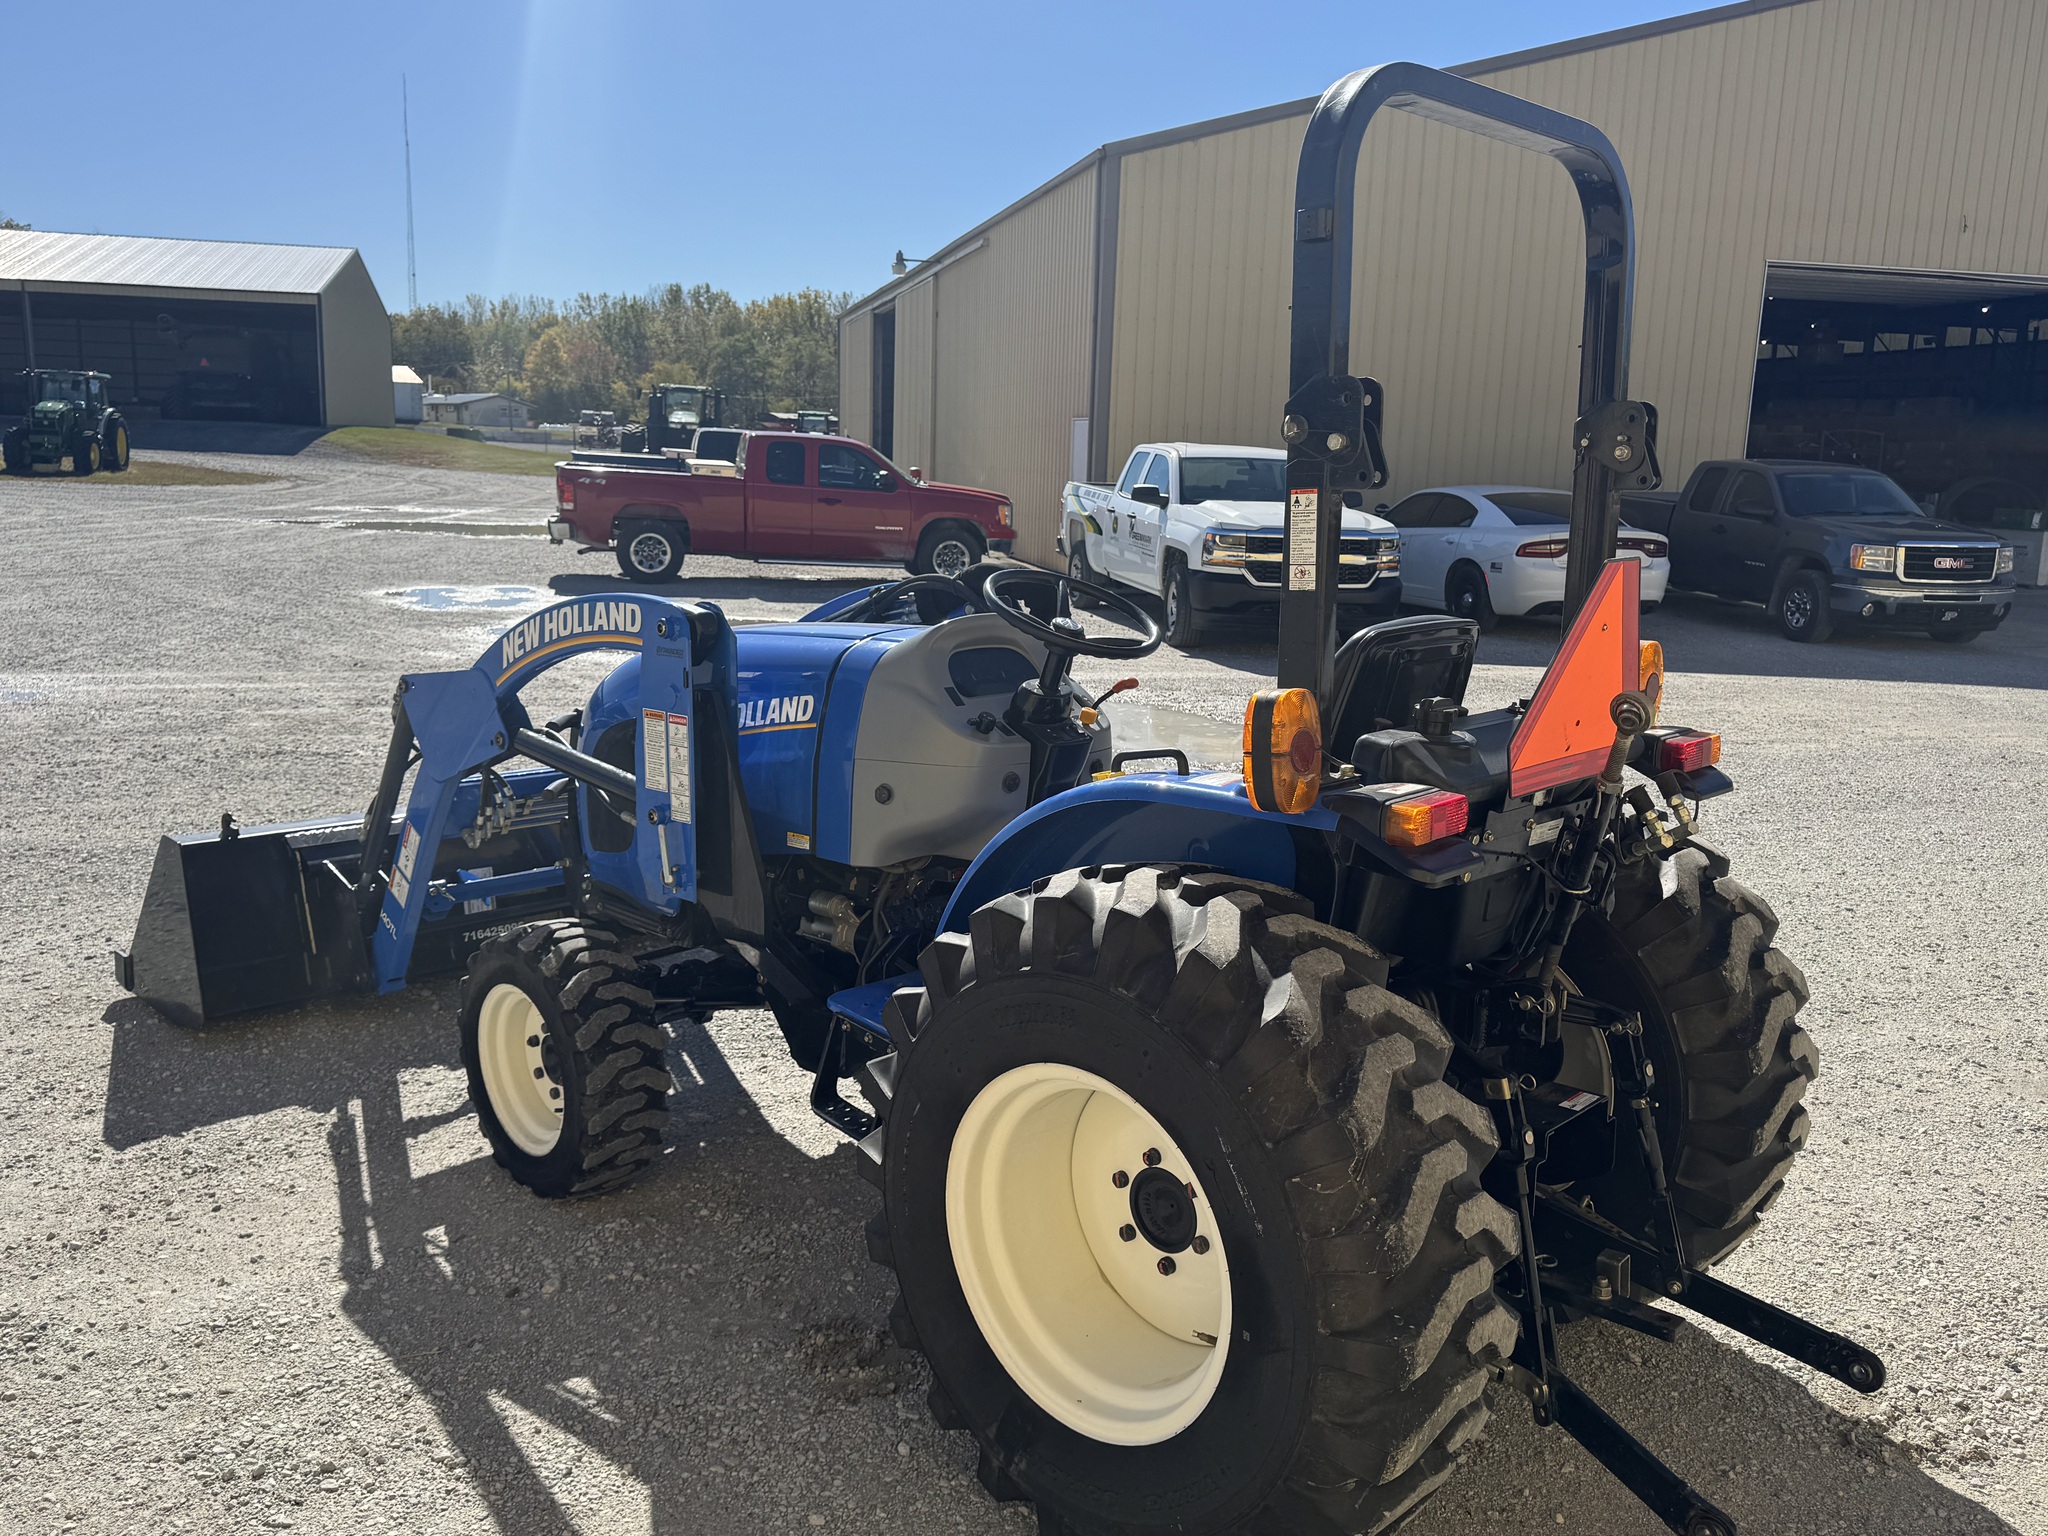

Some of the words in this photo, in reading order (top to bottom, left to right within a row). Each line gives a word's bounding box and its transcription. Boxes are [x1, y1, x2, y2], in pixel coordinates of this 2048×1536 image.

[1934, 557, 1975, 569] GMC
[502, 614, 540, 669] NEW
[544, 601, 642, 643] HOLLAND
